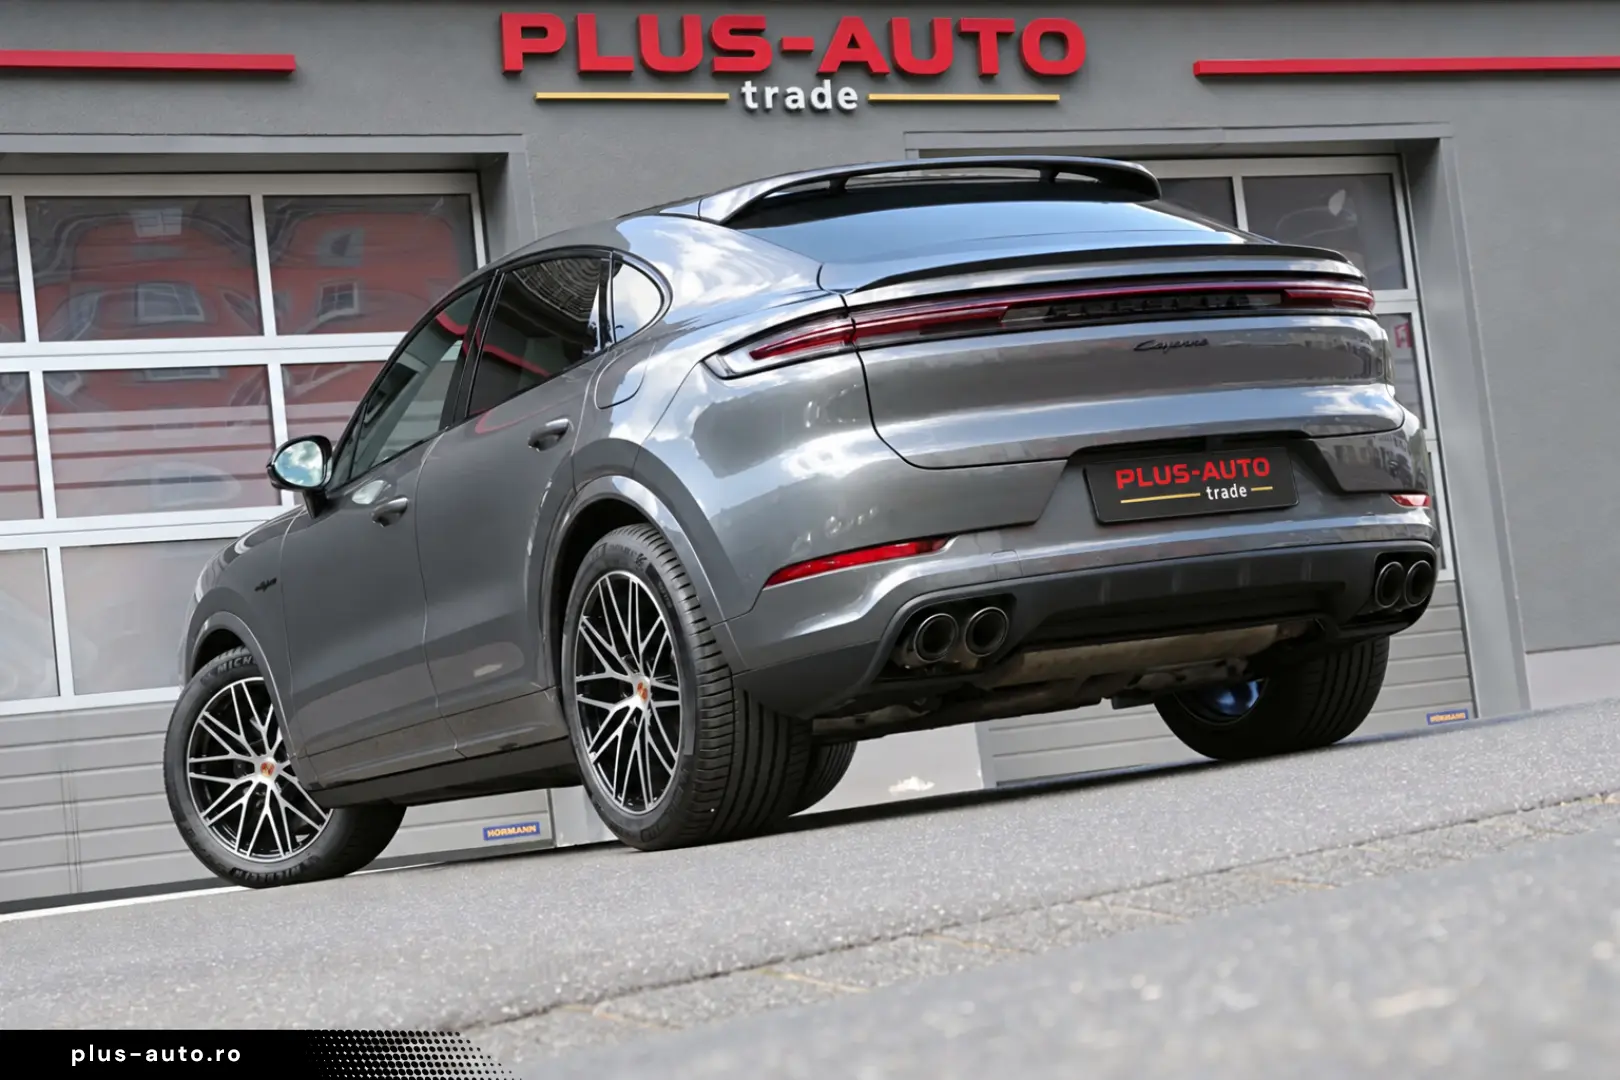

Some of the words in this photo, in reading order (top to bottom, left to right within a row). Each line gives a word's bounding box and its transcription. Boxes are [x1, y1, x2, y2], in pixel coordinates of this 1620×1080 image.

[501, 12, 1086, 77] PLUS-AUTO
[741, 79, 859, 111] trade
[1115, 457, 1270, 489] PLUS-AUTO
[1206, 483, 1248, 500] trade
